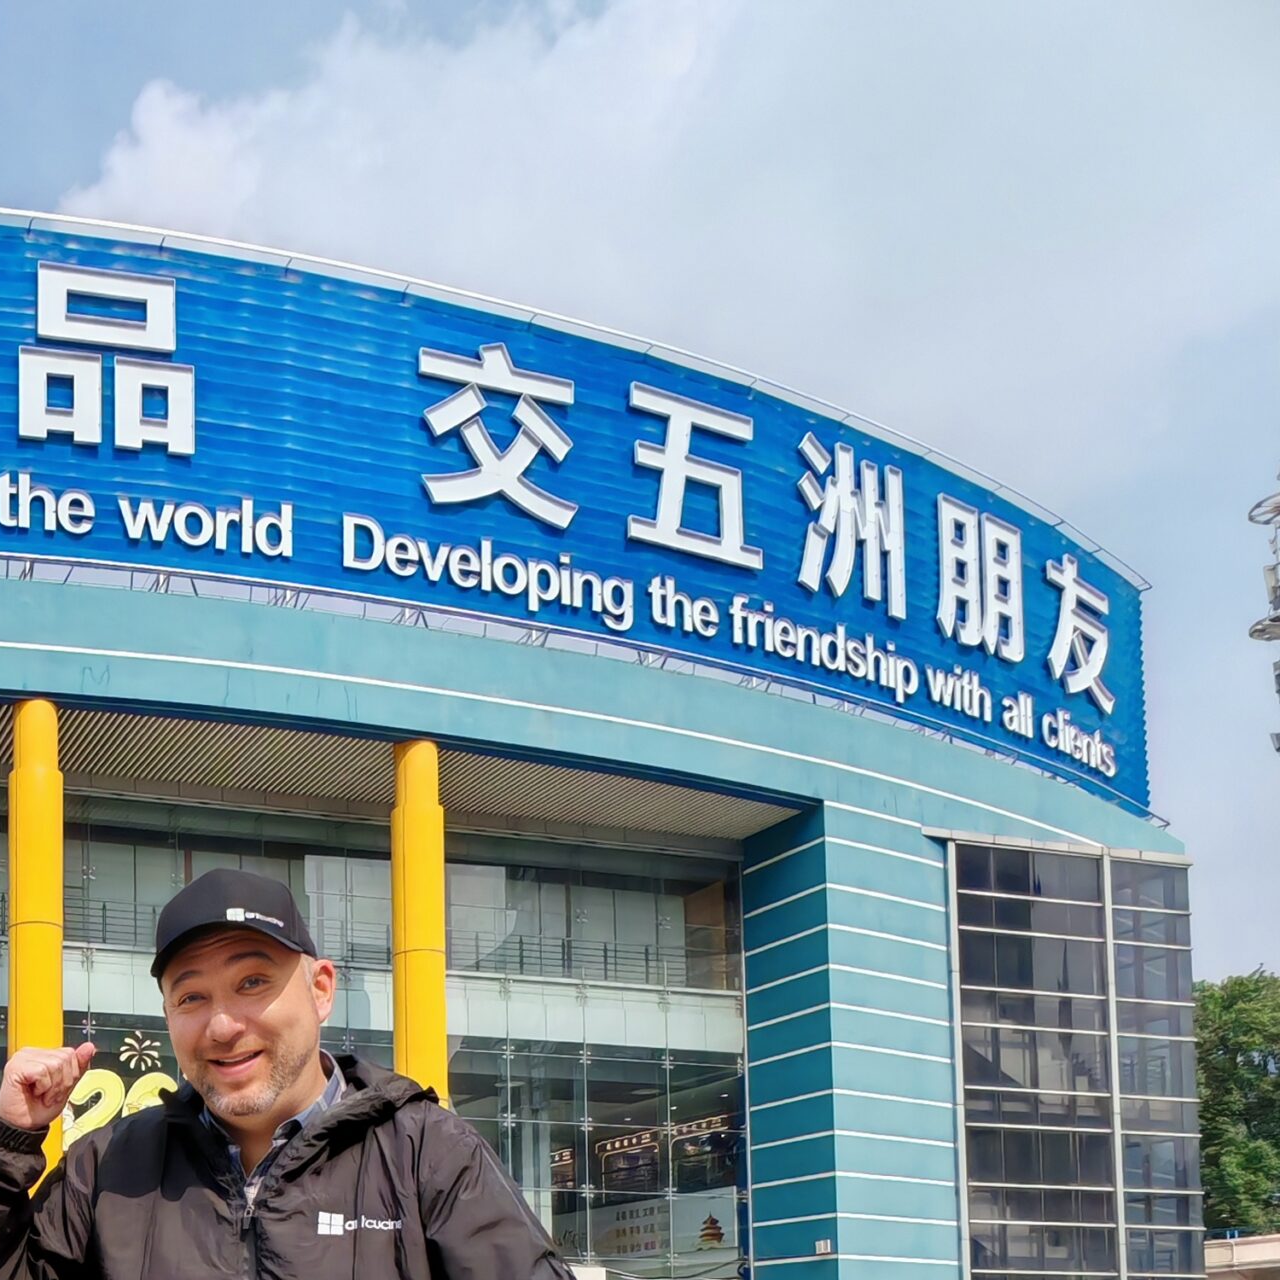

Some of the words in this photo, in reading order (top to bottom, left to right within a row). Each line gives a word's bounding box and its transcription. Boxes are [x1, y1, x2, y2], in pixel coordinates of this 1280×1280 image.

[117, 495, 294, 558] world
[342, 513, 635, 632] Developing
[648, 574, 720, 638] the
[728, 592, 919, 704] friendship
[925, 664, 993, 723] with
[1001, 690, 1035, 739] all
[1041, 707, 1118, 779] clients
[418, 342, 1117, 714] 交五洲朋友
